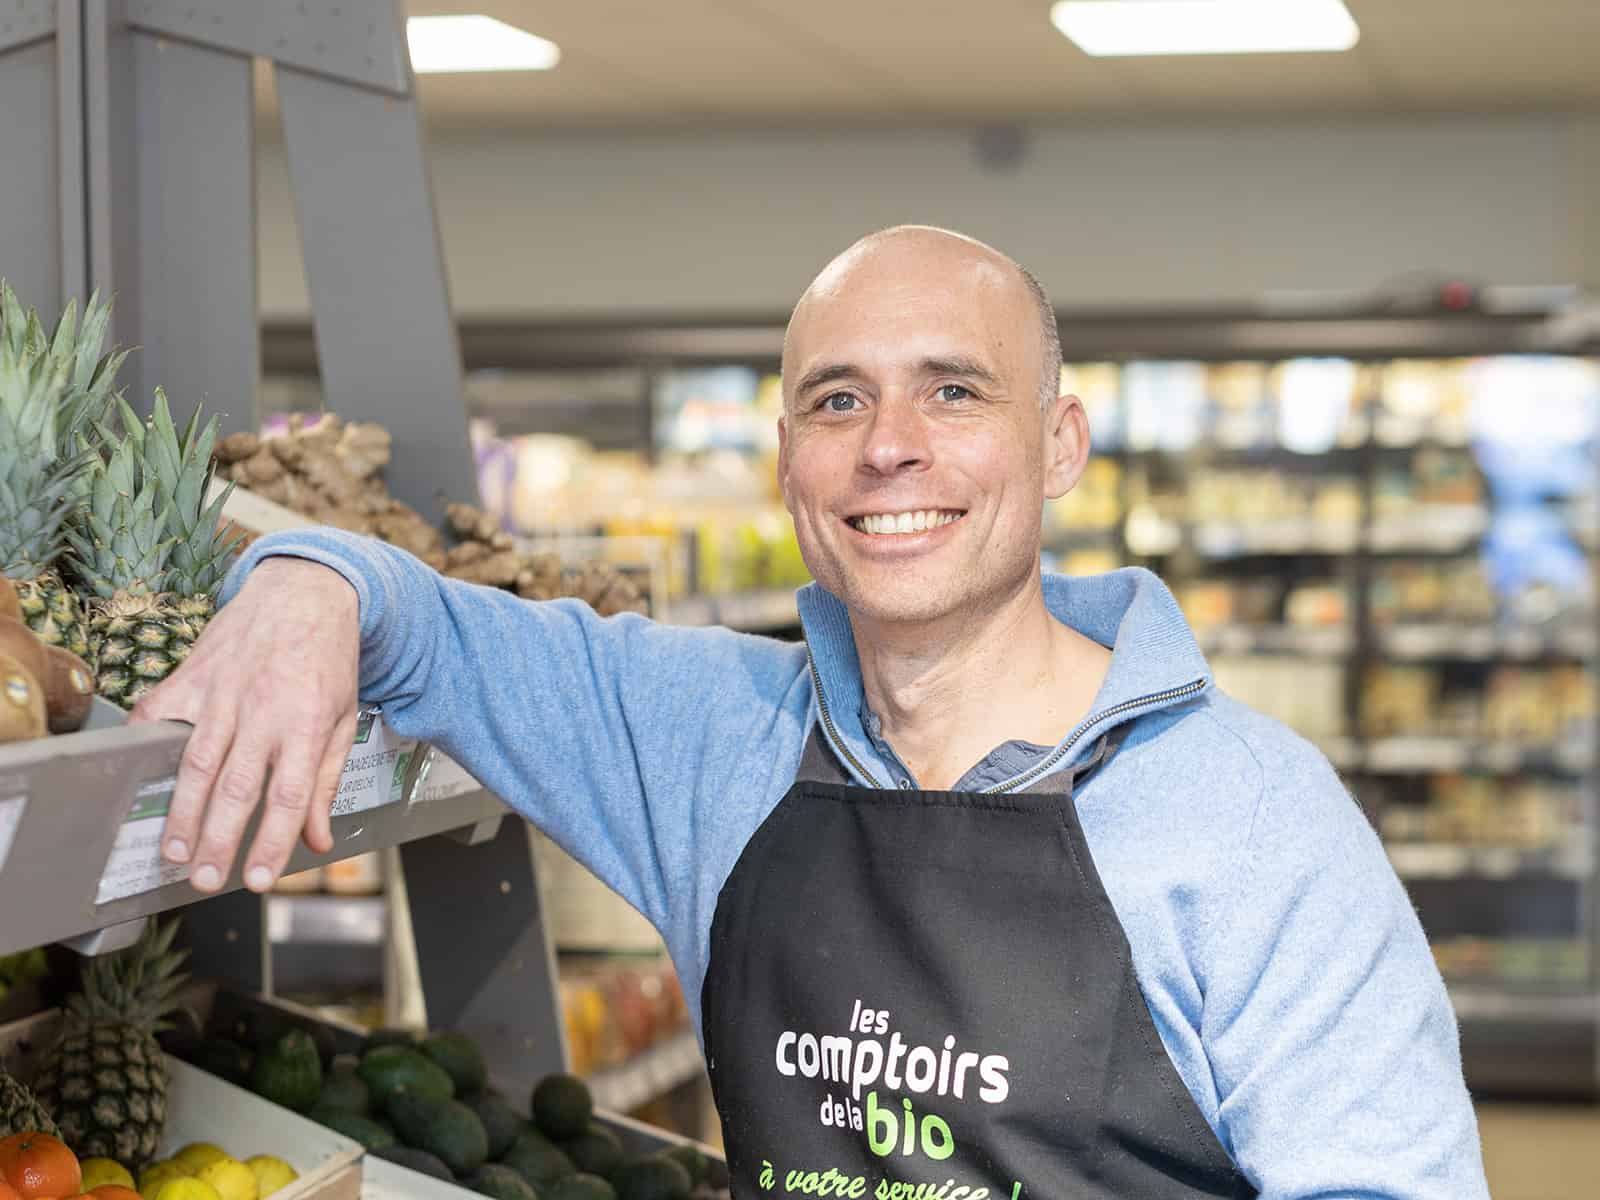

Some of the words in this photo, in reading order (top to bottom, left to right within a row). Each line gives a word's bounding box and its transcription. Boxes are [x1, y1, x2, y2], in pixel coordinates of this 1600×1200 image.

[331, 796, 357, 811] PAGNE
[850, 999, 890, 1035] les
[775, 1030, 1010, 1104] comptoirs
[820, 1093, 846, 1128] de
[846, 1098, 864, 1132] la
[866, 1091, 956, 1161] bio
[759, 1160, 776, 1190] à
[785, 1167, 867, 1199] votre
[875, 1179, 991, 1200] service
